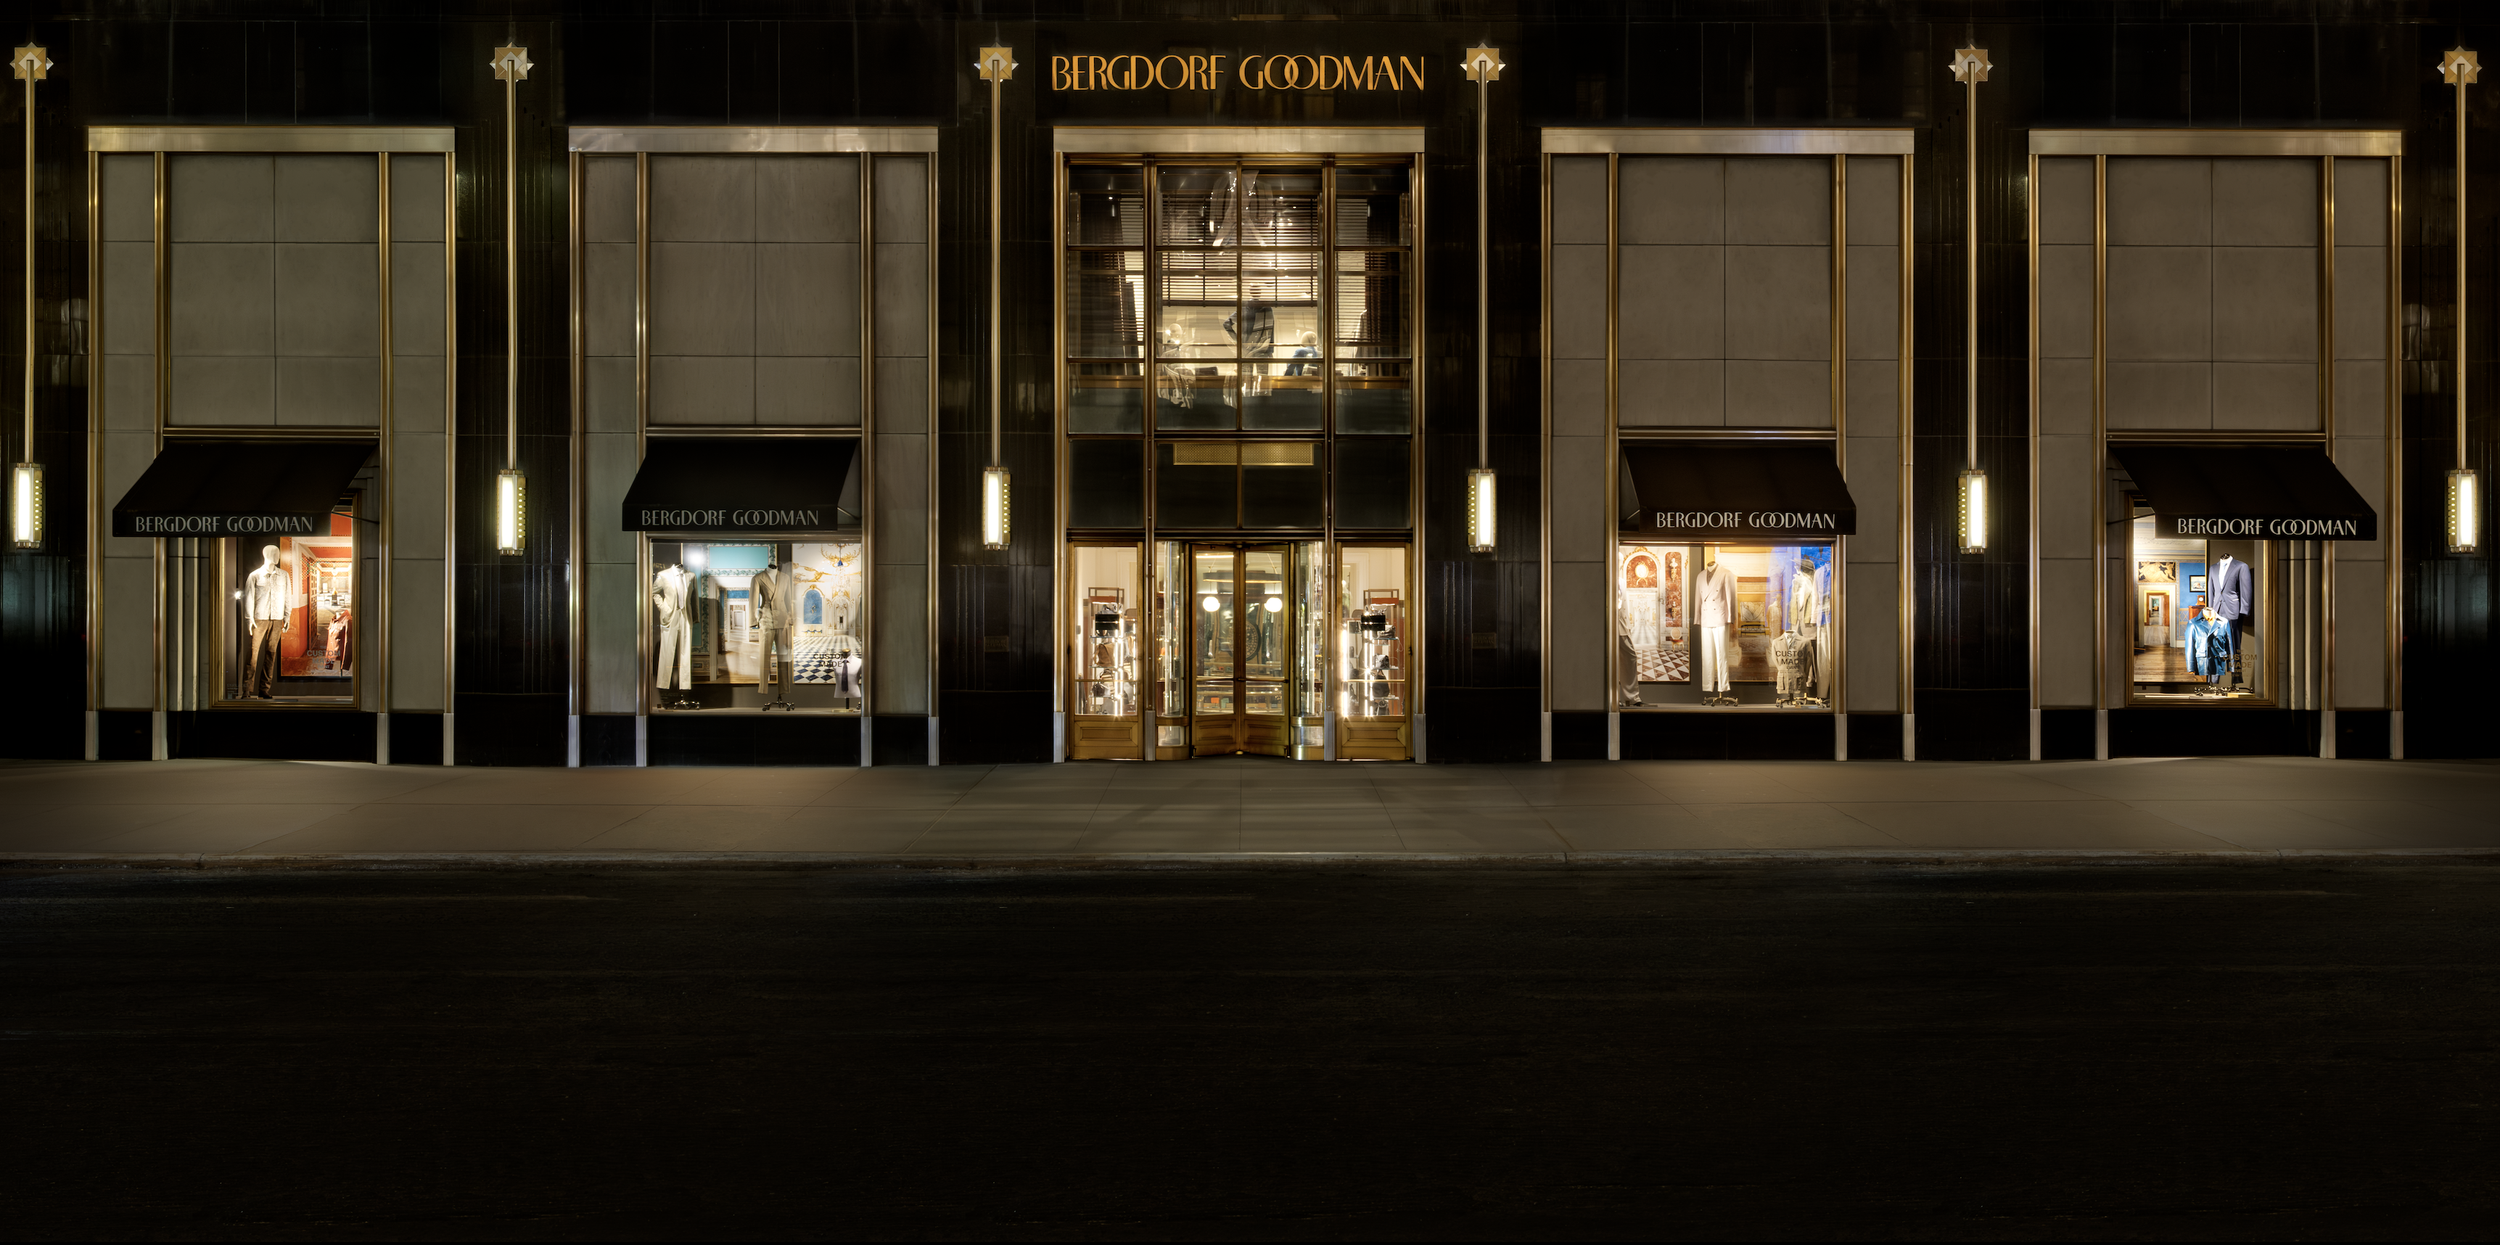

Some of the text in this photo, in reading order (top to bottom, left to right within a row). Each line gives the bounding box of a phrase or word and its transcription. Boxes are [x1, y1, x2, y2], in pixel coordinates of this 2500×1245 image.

[1052, 55, 1425, 91] BERGDORF GOODMAN
[136, 516, 313, 532] BERGDORF GOODMAN
[641, 509, 819, 526] BERGDORF GOODMAN
[1656, 511, 1836, 530] BERGDORF GOODMAN
[2177, 518, 2357, 536] BERGDORF GOODMAN
[312, 657, 335, 665] MADE
